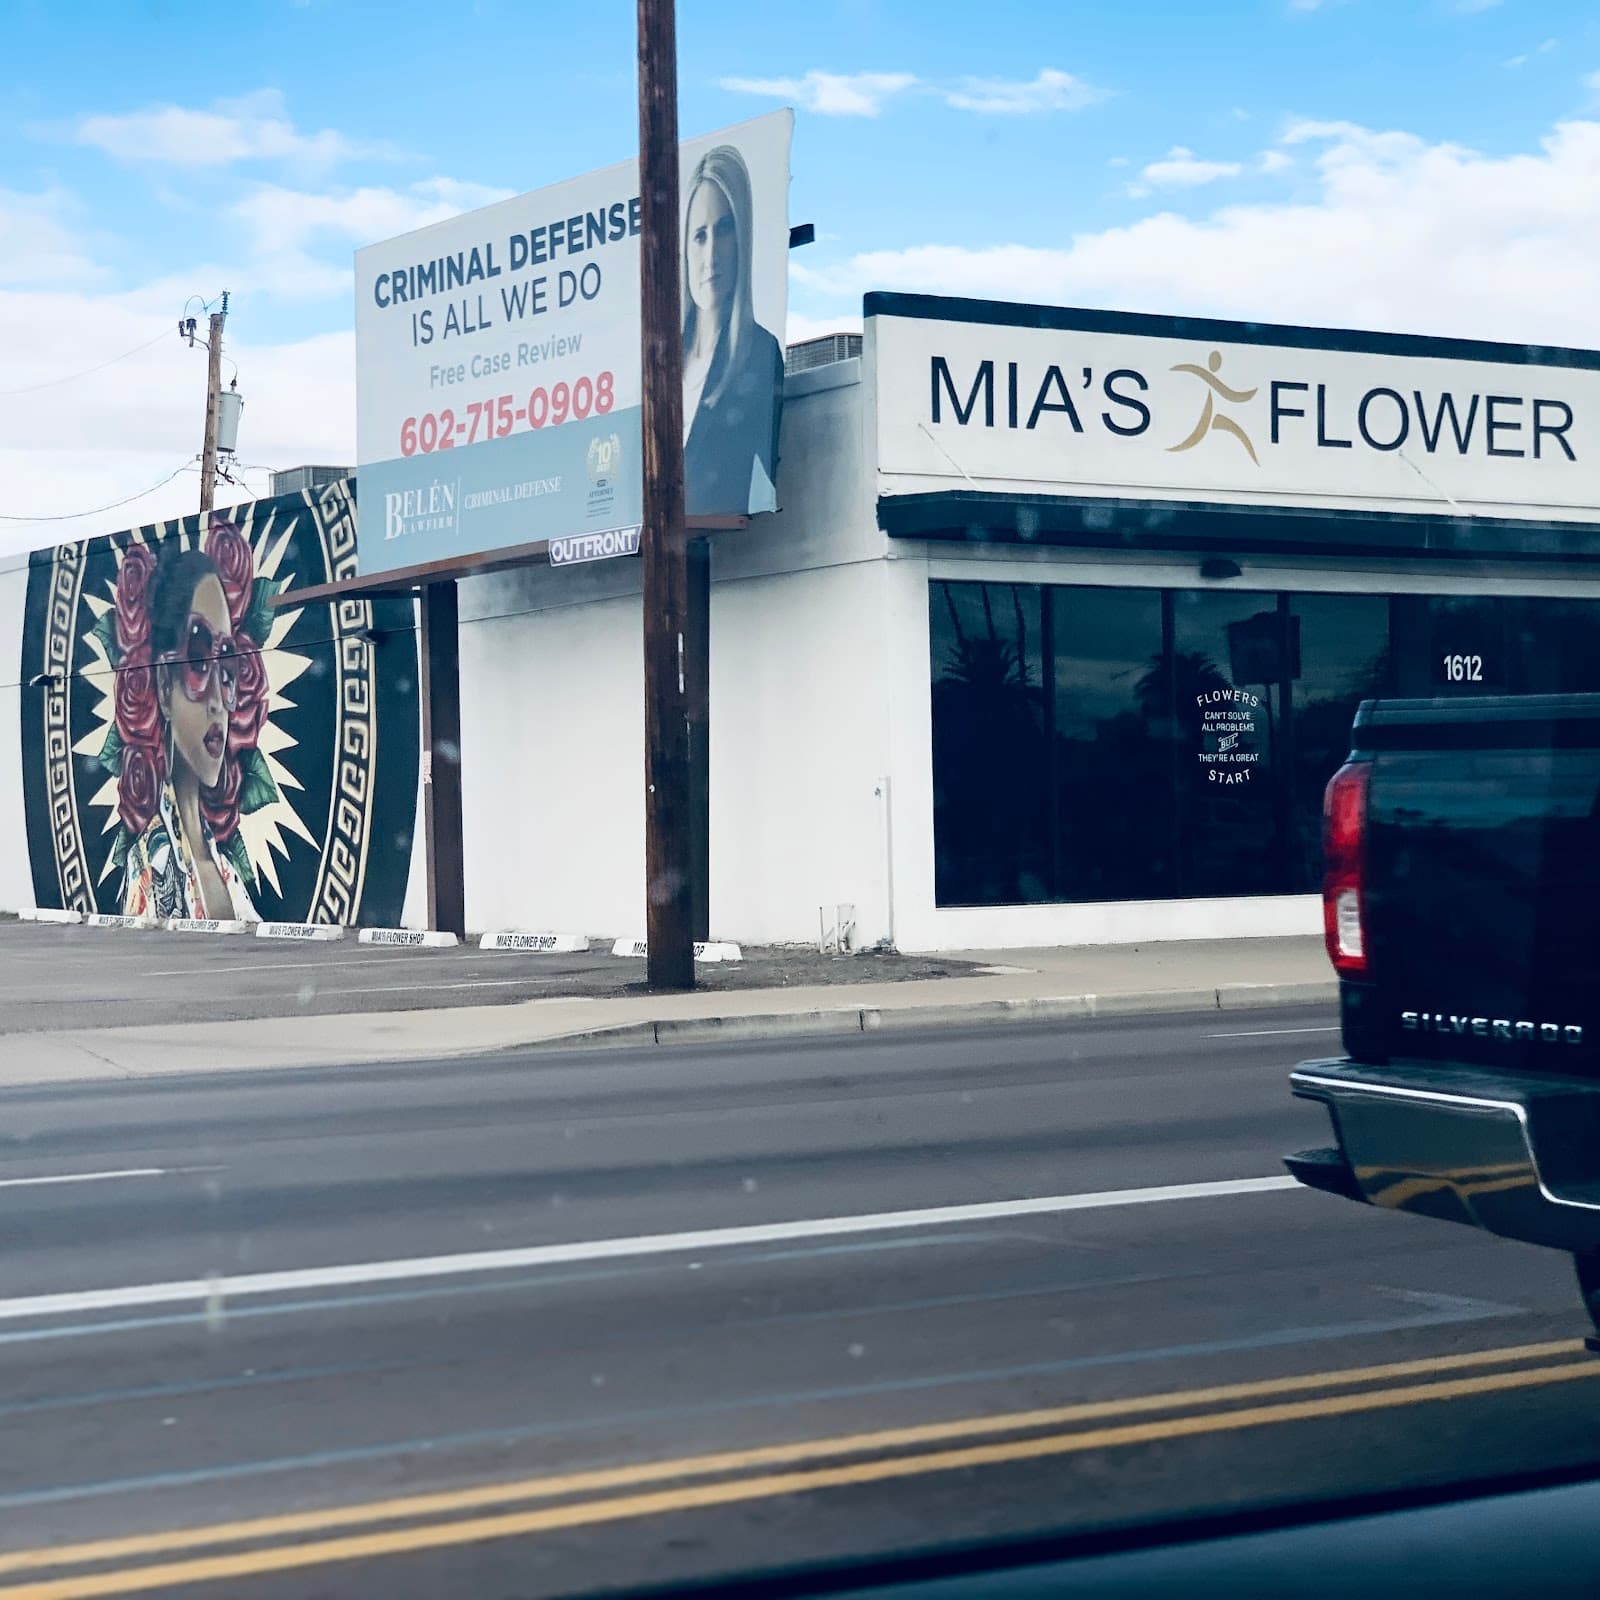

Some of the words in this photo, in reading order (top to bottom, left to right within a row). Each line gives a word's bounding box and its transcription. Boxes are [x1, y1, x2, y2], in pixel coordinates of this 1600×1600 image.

[374, 242, 501, 308] CRIMINAL
[510, 196, 641, 271] DEFENSE
[412, 309, 434, 346] IS
[443, 295, 492, 339] ALL
[501, 276, 547, 322] WE
[558, 262, 601, 308] DO
[430, 364, 465, 388] Free
[471, 352, 511, 379] Case
[517, 333, 583, 367] Review
[400, 371, 614, 457] 602-715-0908
[930, 355, 1151, 437] MIA'S
[1269, 380, 1578, 462] FLOWER
[464, 487, 513, 510] CRIMINAL
[514, 476, 562, 500] DEFENSE
[384, 479, 455, 540] BELÉN
[552, 528, 636, 562] OUTFRONT
[1443, 654, 1483, 681] 1612
[1196, 689, 1259, 707] FLOWERS
[1204, 711, 1226, 720] CAN'T
[1227, 711, 1251, 720] SOLVE
[1201, 722, 1215, 732] ALL
[1216, 722, 1255, 732] PROBLEMS
[1220, 736, 1235, 749] BUT
[1198, 753, 1228, 762] THEY'RE
[1229, 753, 1235, 762] A
[1235, 753, 1259, 762] GREAT
[1208, 768, 1251, 785] START
[282, 926, 300, 937] FLOWER
[300, 926, 315, 937] SHOP
[386, 931, 409, 944] FLOWER
[409, 932, 425, 945] SHOP
[496, 935, 512, 947] MIA'S
[513, 935, 538, 948] FLOWER
[538, 936, 557, 949] SHOP
[632, 941, 647, 954] MIA
[1401, 1011, 1583, 1043] SILVERADO
